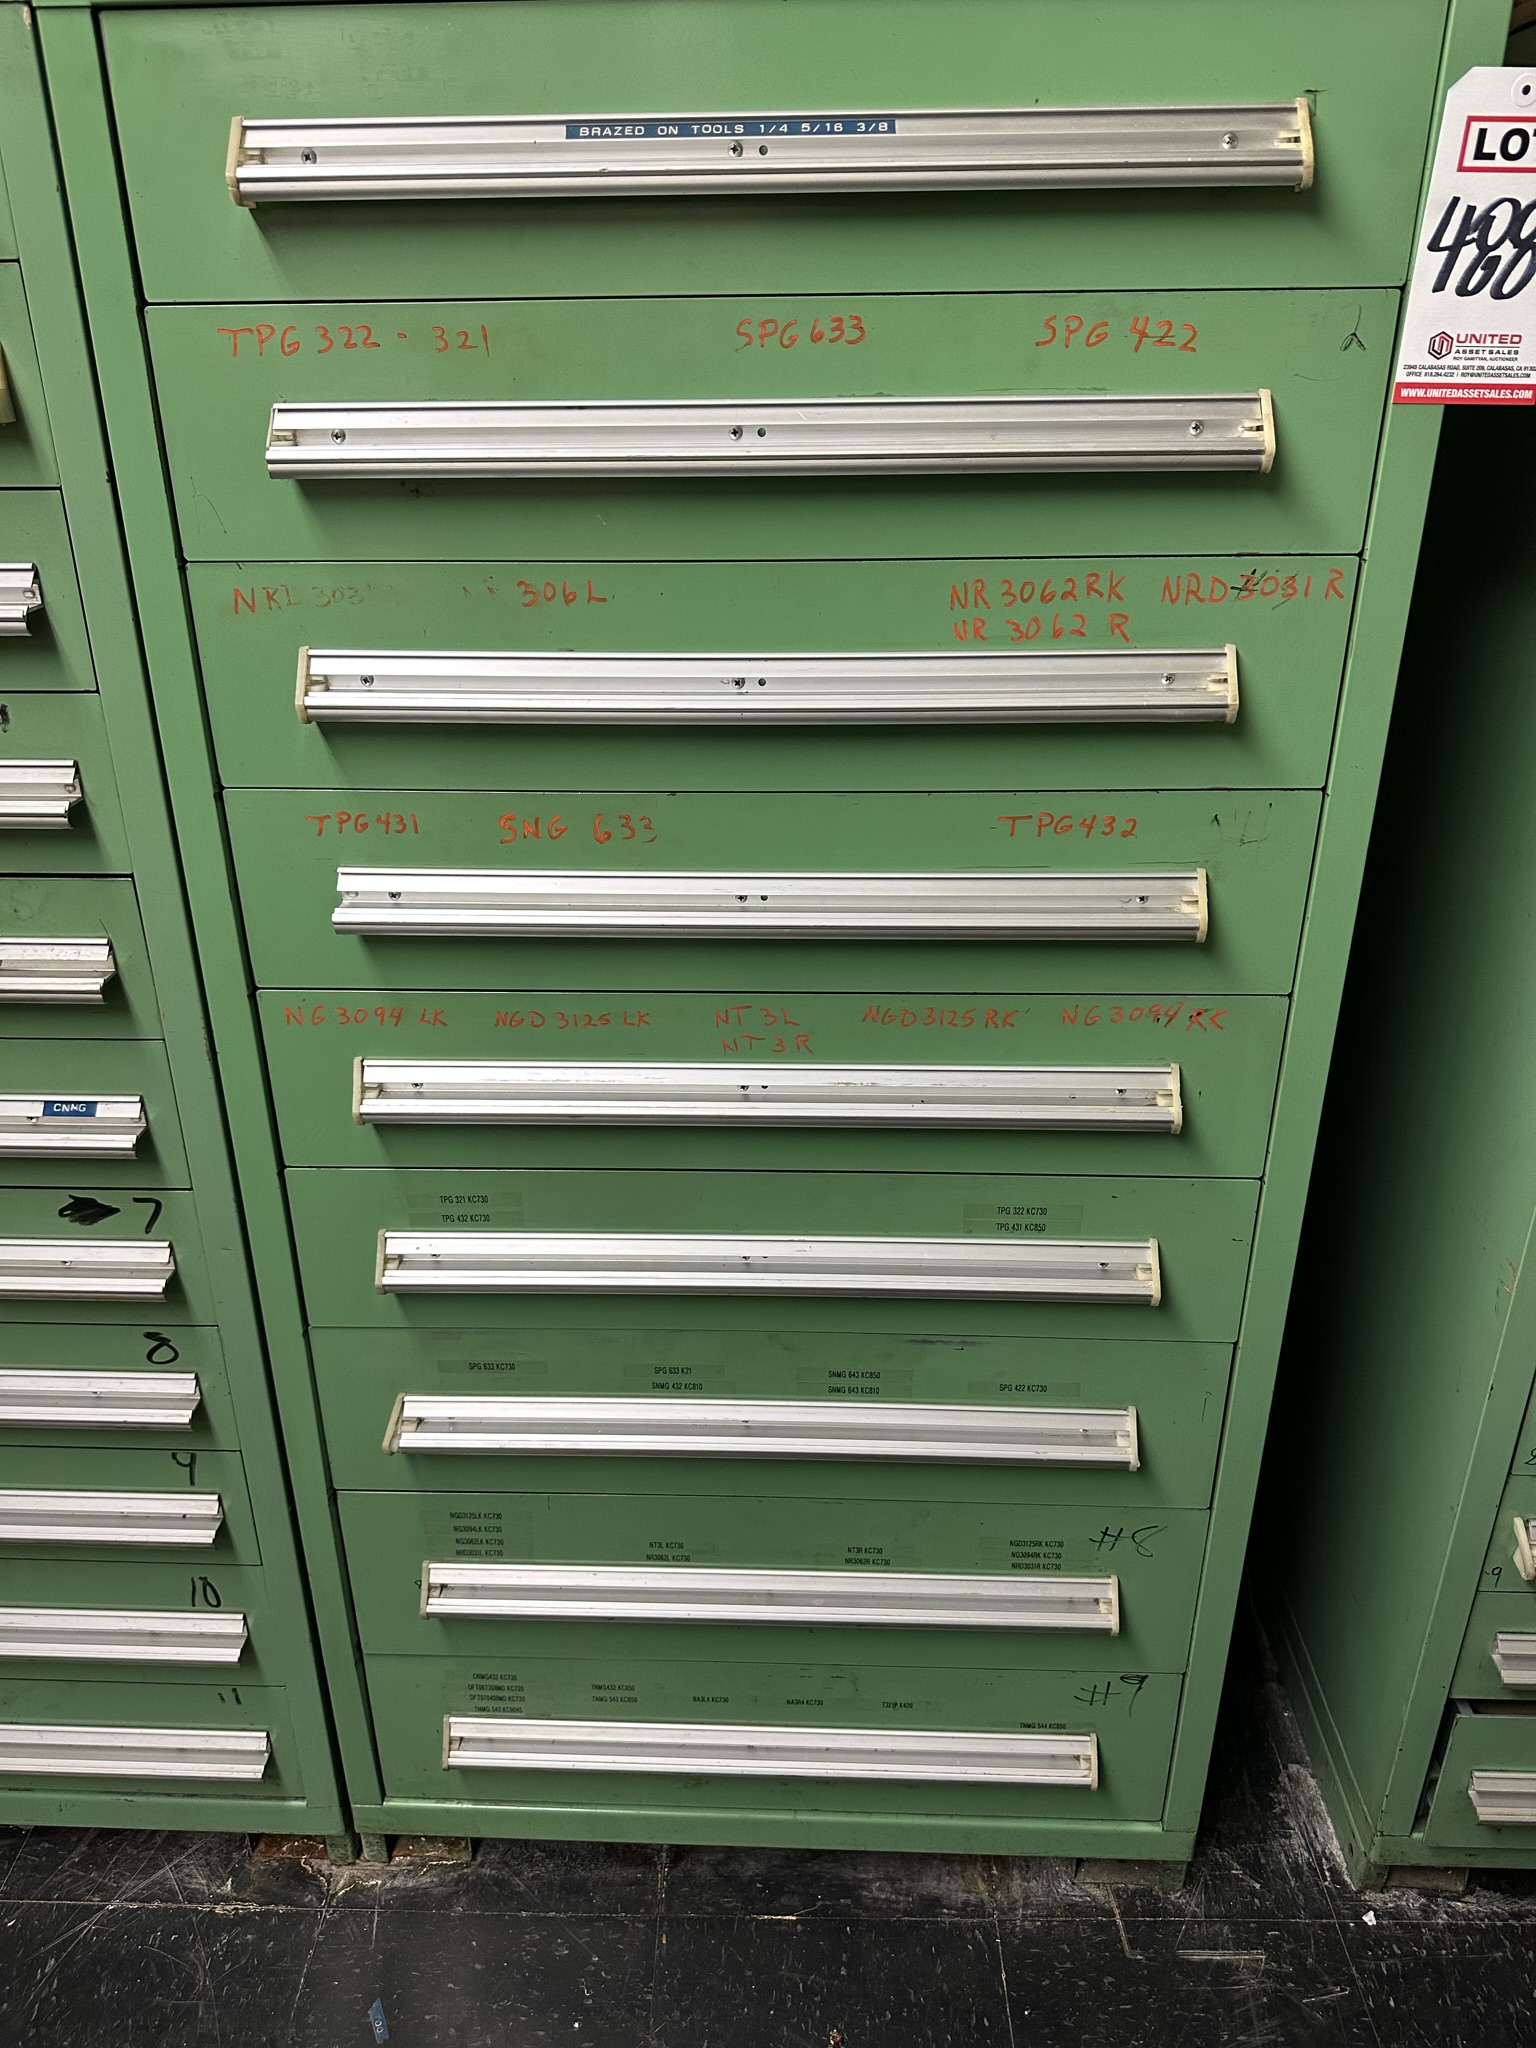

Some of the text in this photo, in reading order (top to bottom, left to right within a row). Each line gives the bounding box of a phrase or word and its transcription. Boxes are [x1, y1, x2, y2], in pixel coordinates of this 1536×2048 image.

[580, 121, 889, 137] BRAZED ON TOOLS 1/4 5/16 3/8
[1473, 127, 1536, 162] LO
[735, 314, 866, 353] SPG 633
[1035, 314, 1199, 354] SPG 422
[217, 324, 300, 357] TPG
[316, 325, 380, 354] 322
[432, 324, 493, 358] 321
[1456, 333, 1523, 345] UNITED
[1400, 387, 1534, 399] WWW.UNITEDASSETSALES.COM
[500, 812, 657, 844] SNG 633
[53, 1103, 87, 1112] CNMG
[440, 1195, 489, 1204] TPG 321 KC730
[132, 1197, 162, 1234] 7
[997, 1206, 1047, 1216] TPG 322 KC730
[441, 1214, 490, 1223] TPG 432 KC730
[996, 1222, 1046, 1232] TPG 431 KC850
[143, 1331, 179, 1364] 8
[468, 1362, 516, 1371] SPG 633 KC730
[654, 1366, 692, 1375] SPG 633 K21
[828, 1370, 881, 1380] SNMG 643 KC850
[651, 1381, 703, 1391] SNMG 432 KC810
[828, 1386, 880, 1395] SNMG 643 KC810
[999, 1383, 1048, 1393] SPG 422 KC730
[483, 1512, 503, 1520] KC730
[484, 1525, 503, 1533] KC730
[485, 1538, 505, 1546] KC730
[665, 1541, 685, 1549] KC730
[1044, 1540, 1064, 1548] KC730
[485, 1549, 504, 1557] KC730
[864, 1547, 883, 1555] KC730
[671, 1554, 691, 1562] KC730
[872, 1558, 891, 1566] KC730
[1042, 1562, 1062, 1570] KC730
[191, 1576, 222, 1608] 10
